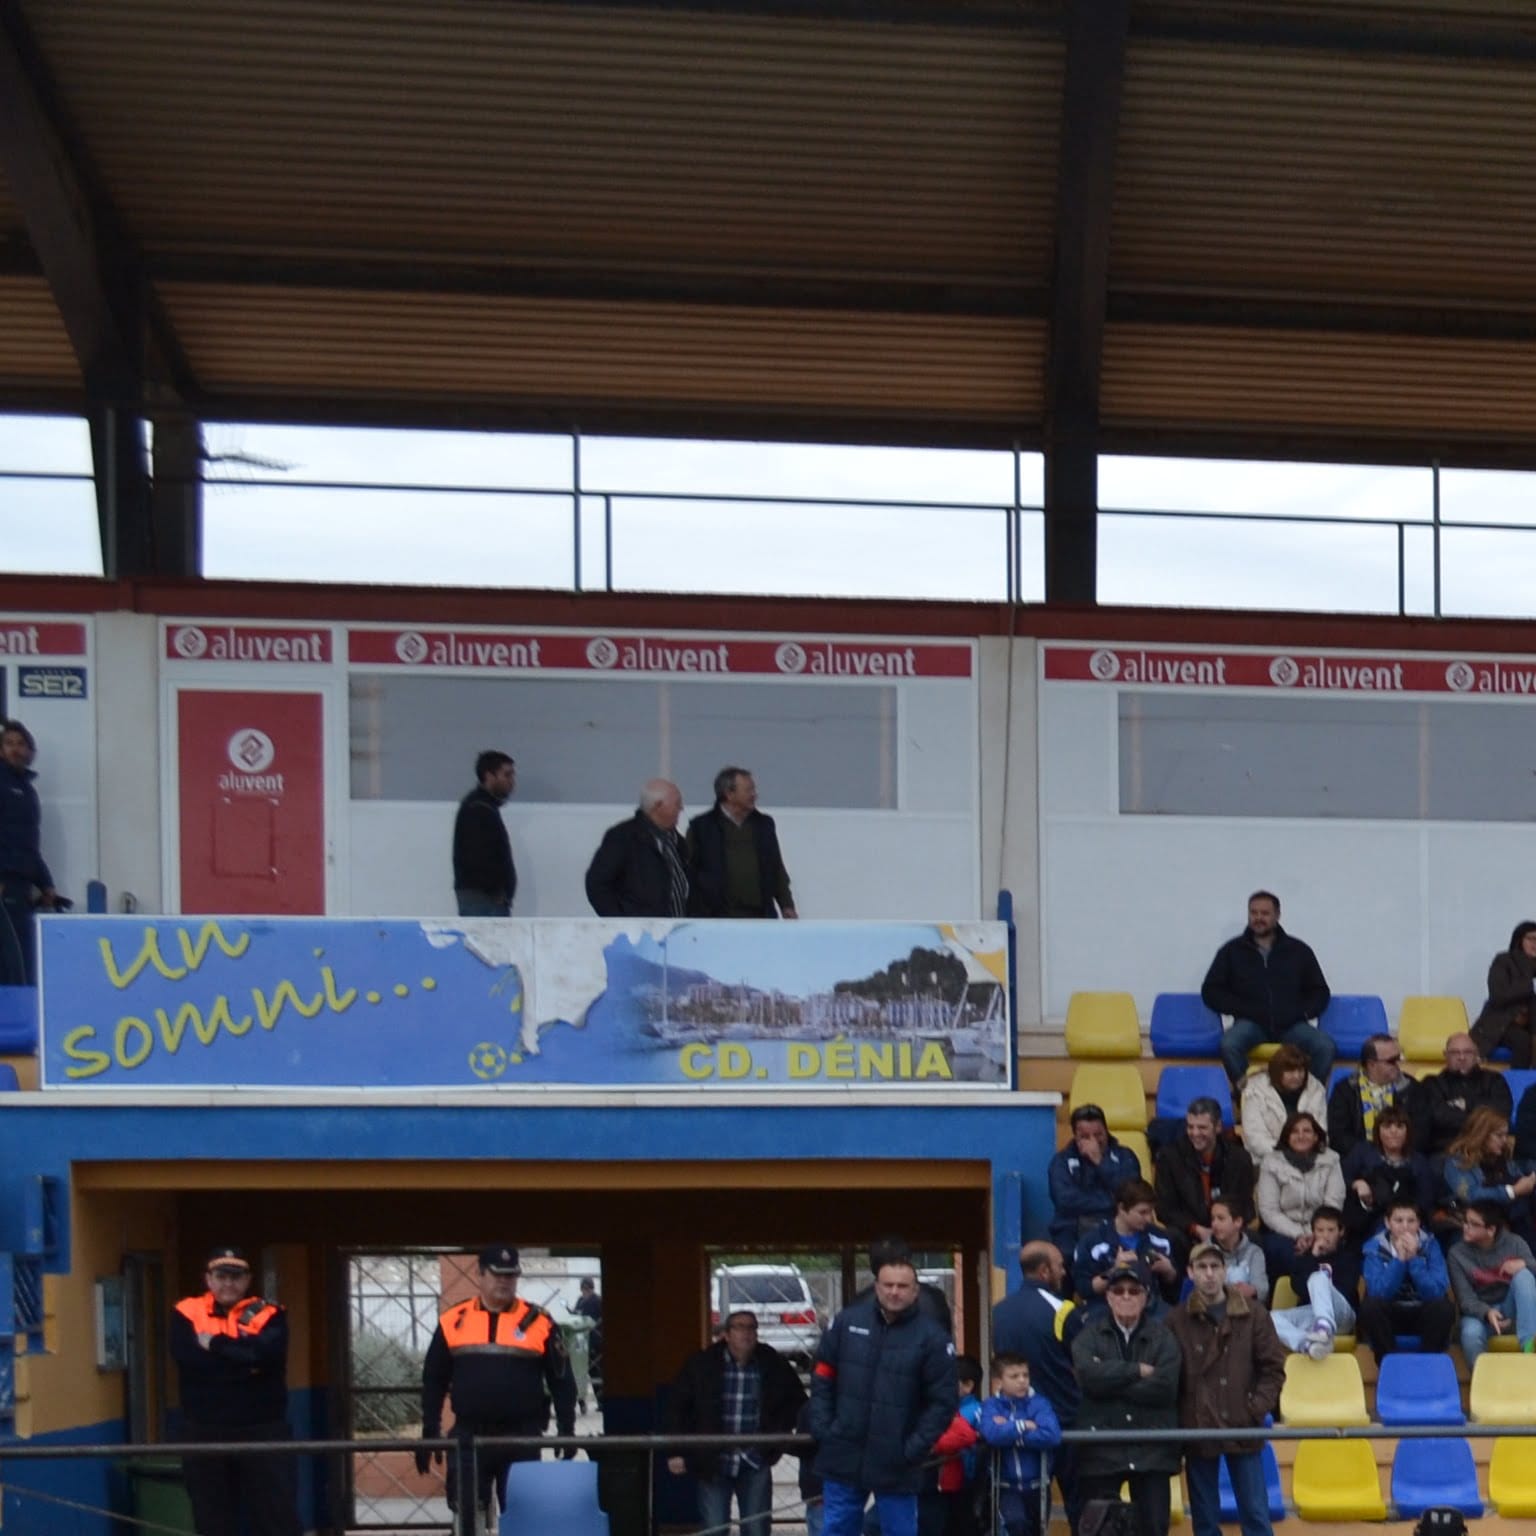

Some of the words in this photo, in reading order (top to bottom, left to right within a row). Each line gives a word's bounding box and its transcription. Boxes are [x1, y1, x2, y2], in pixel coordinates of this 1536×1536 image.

[211, 627, 322, 661] aluvent
[432, 633, 541, 667] aluvent
[623, 638, 729, 672] aluvent
[811, 643, 916, 676] aluvent
[23, 674, 83, 696] SER
[1124, 651, 1226, 685] aluvent
[1303, 657, 1404, 690] aluvent
[219, 770, 283, 792] aluvent
[98, 920, 250, 989] un
[679, 1042, 768, 1080] CD.
[786, 1032, 954, 1080] DÉNIA
